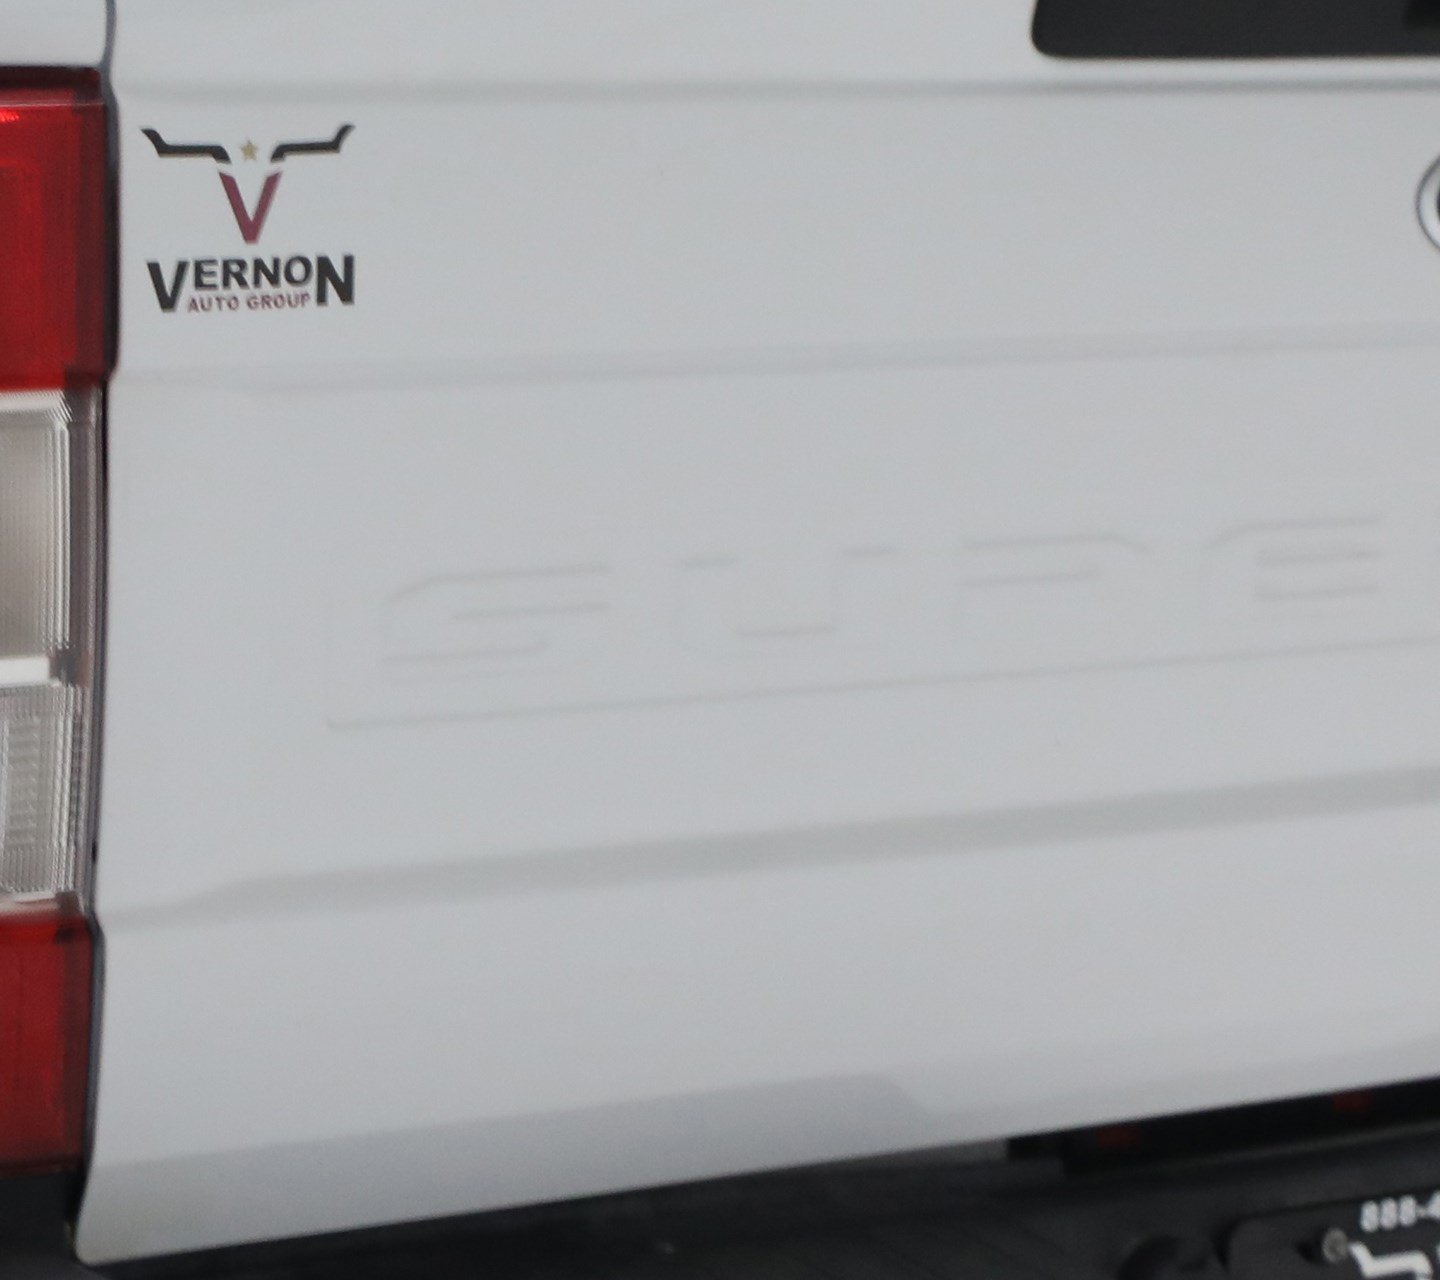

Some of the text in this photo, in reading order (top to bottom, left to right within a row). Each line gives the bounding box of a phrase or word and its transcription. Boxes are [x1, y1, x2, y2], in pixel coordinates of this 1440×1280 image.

[146, 253, 355, 314] VERNON
[187, 291, 311, 313] AUTO GROUP
